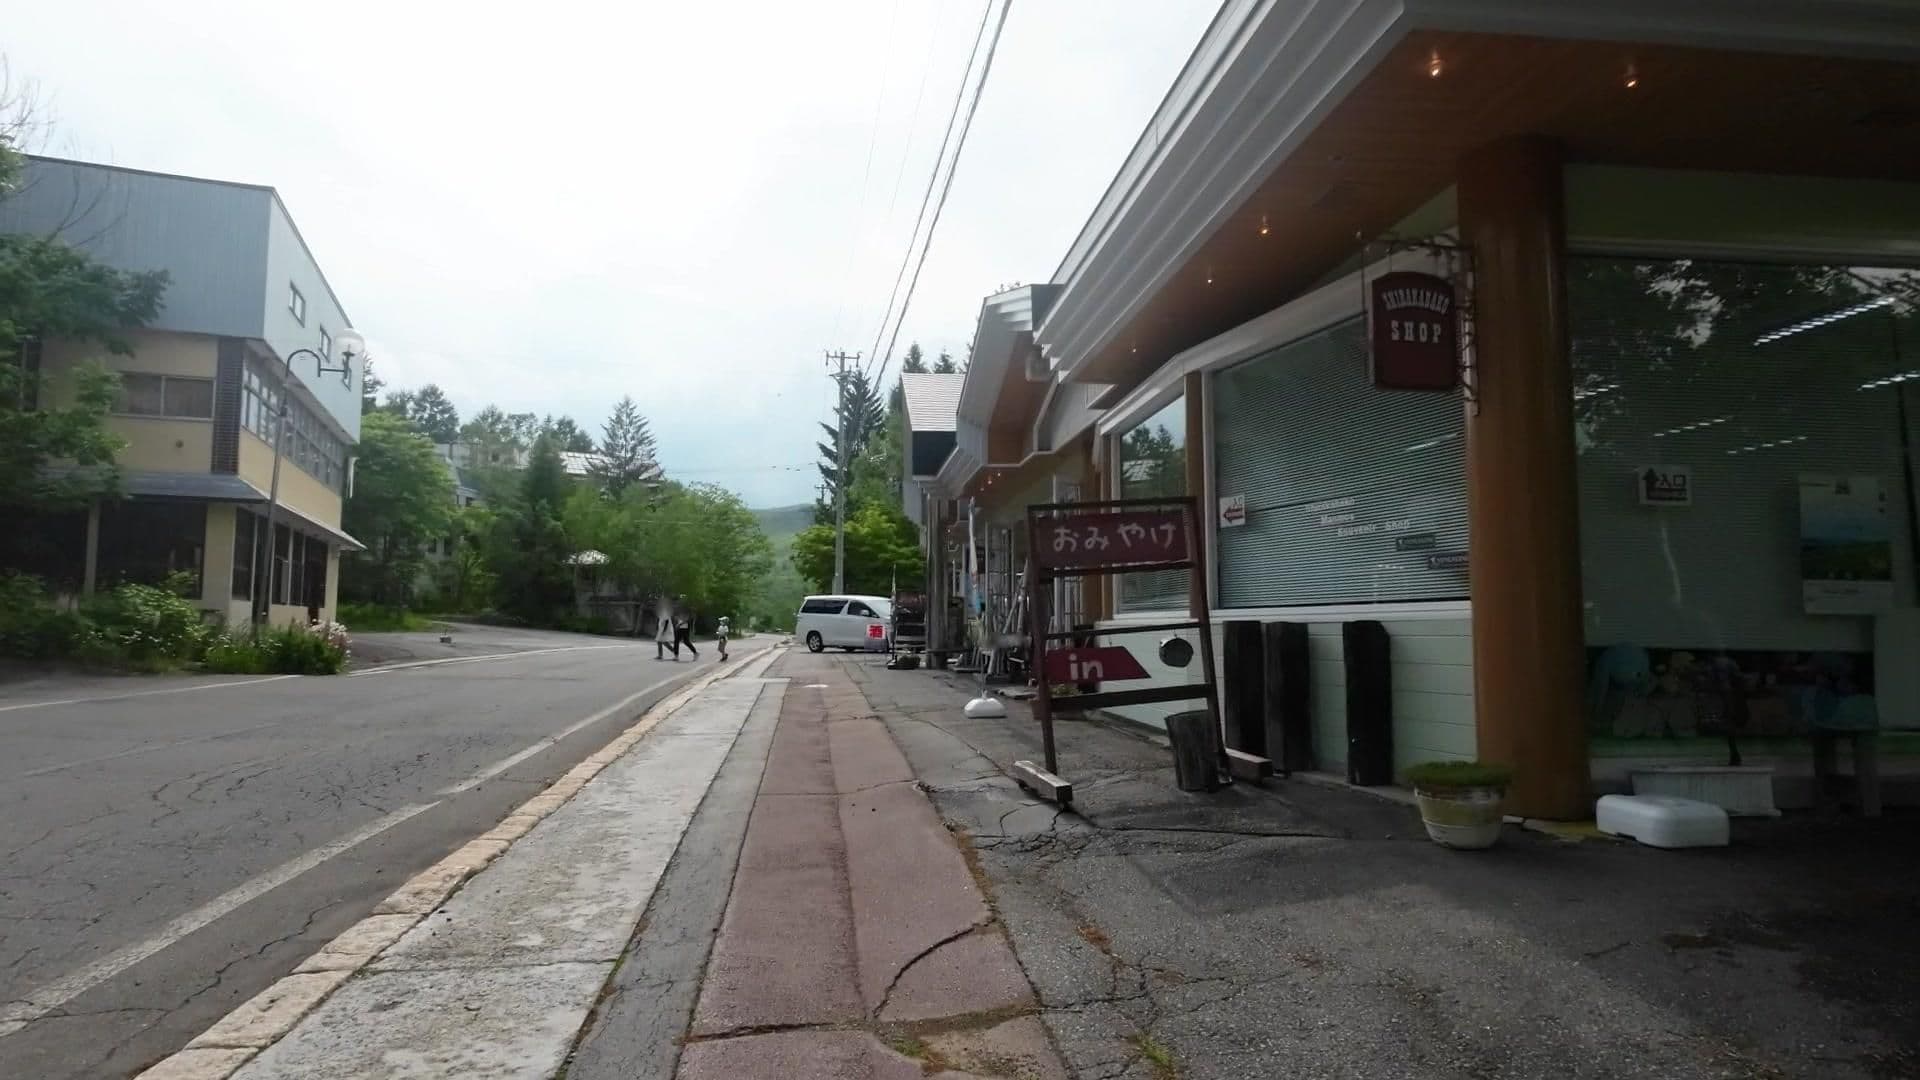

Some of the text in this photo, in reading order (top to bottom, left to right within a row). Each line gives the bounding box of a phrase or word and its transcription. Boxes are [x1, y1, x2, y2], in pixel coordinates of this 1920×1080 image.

[1391, 320, 1442, 343] SHOP
[1659, 474, 1686, 487] 入口
[1384, 519, 1410, 531] Shop
[1068, 653, 1104, 680] in
